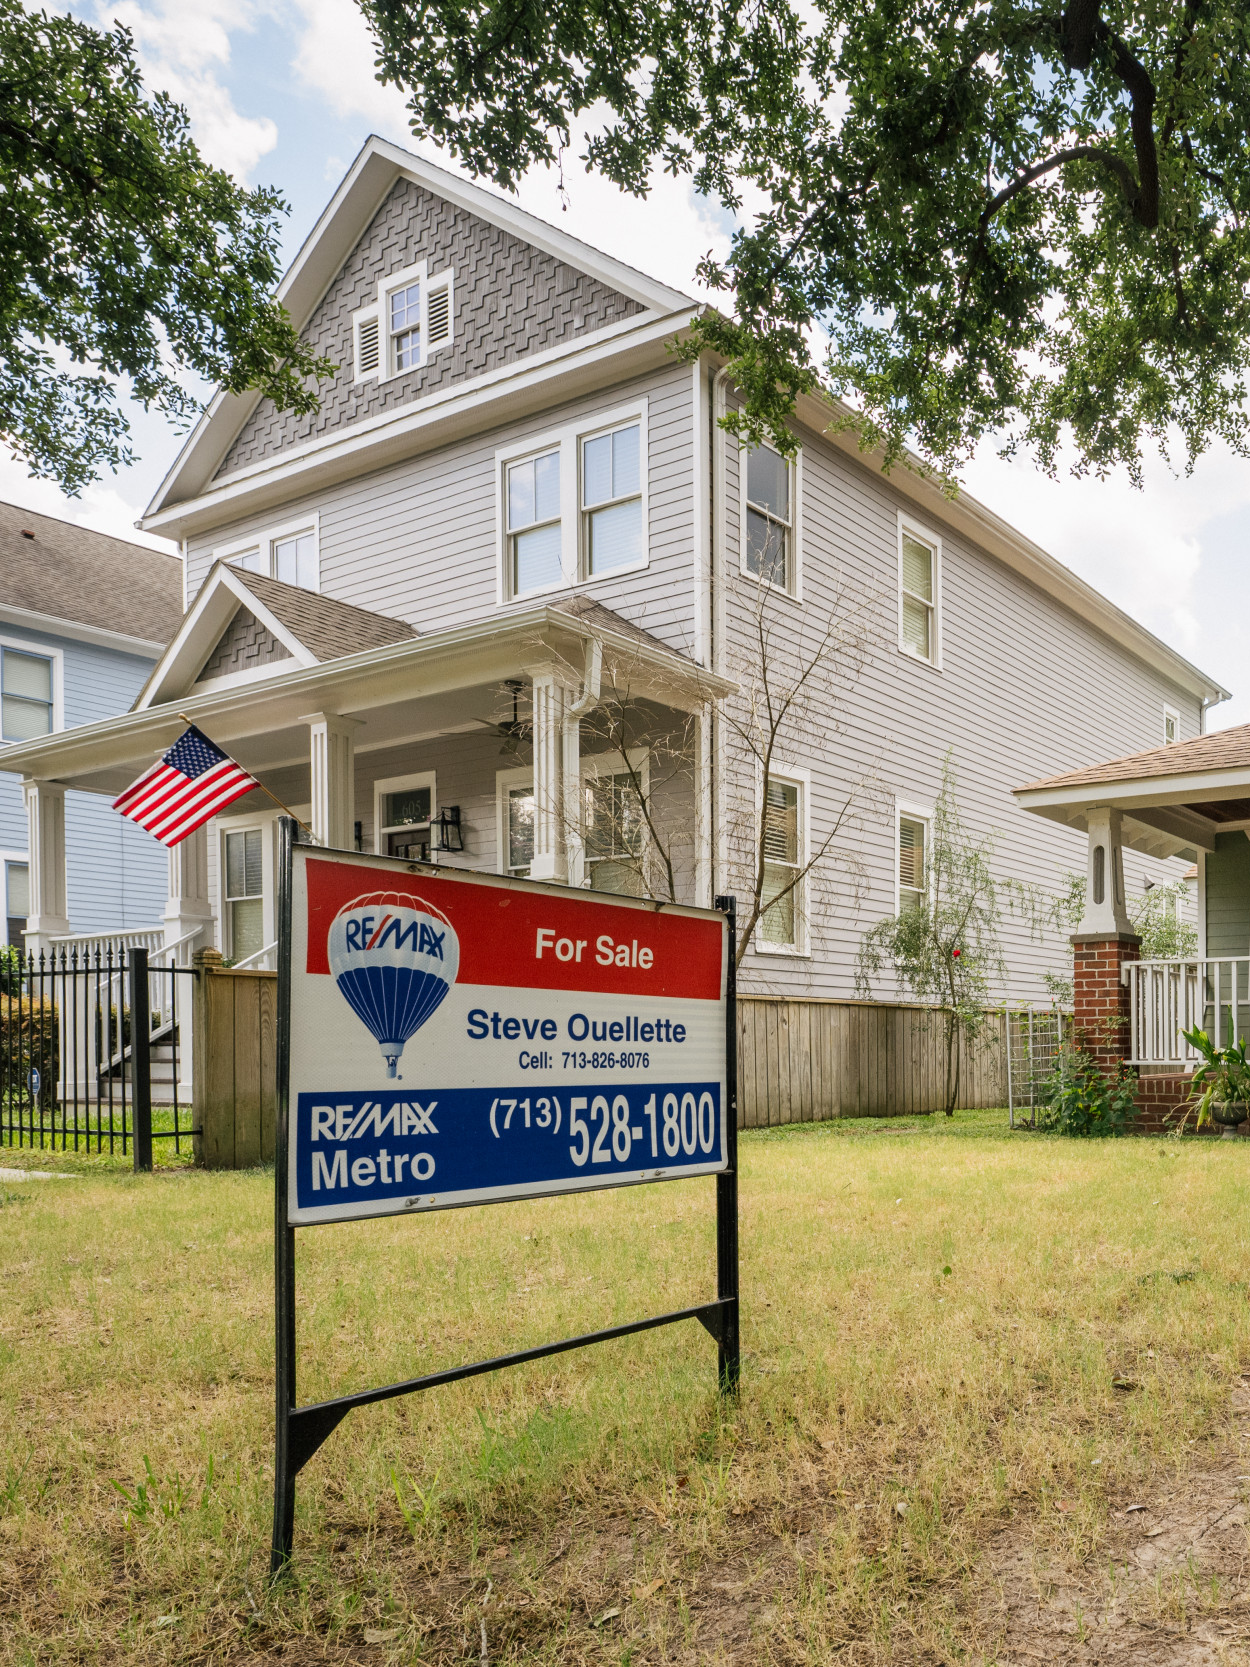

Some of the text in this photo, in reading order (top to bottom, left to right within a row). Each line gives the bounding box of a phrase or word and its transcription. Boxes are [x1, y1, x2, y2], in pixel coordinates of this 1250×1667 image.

[345, 914, 446, 962] RE/MAX
[536, 928, 654, 970] For Sale
[466, 1009, 687, 1043] Steve Ouellette
[518, 1051, 650, 1070] Cell: 713-826-8076
[311, 1101, 440, 1141] RE/MAX
[489, 1092, 715, 1167] (713) 528-1800
[311, 1149, 436, 1190] Metro
